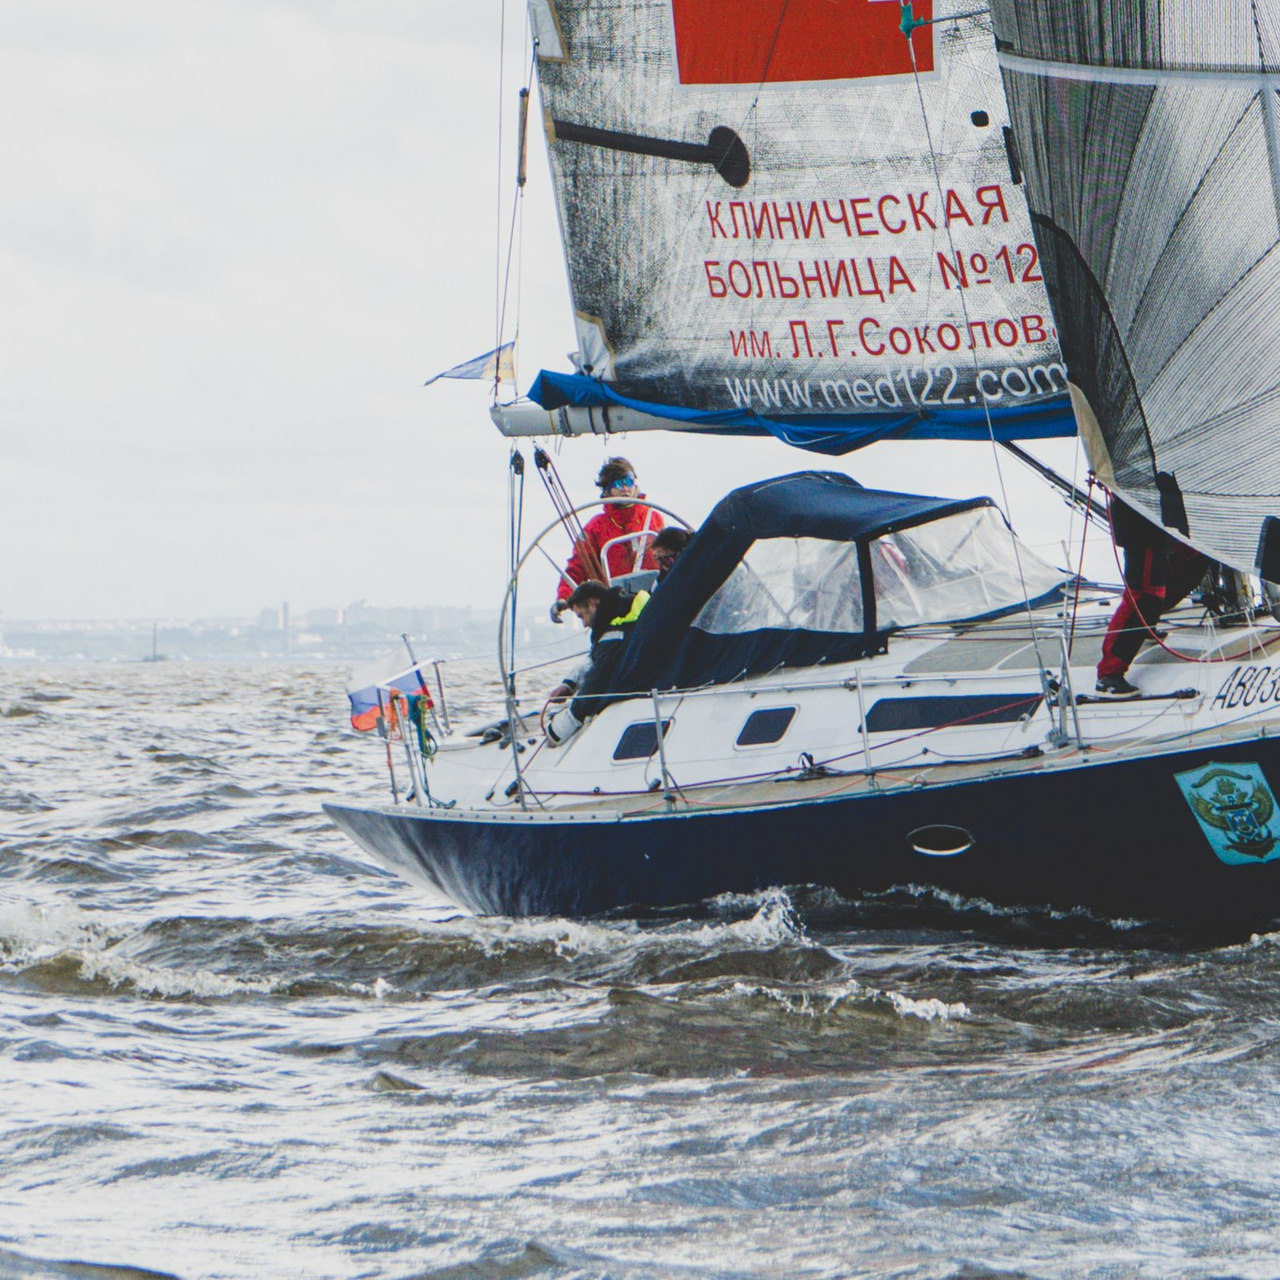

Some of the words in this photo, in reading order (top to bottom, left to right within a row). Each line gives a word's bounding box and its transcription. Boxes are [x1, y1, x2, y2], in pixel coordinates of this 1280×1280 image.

[705, 184, 1009, 239] КЛИНИЧЕСКАЯ
[703, 256, 916, 303] БОЛЬНИЦА
[788, 314, 1057, 358] Л.Г.Соколов
[725, 361, 1068, 409] www.med122.com
